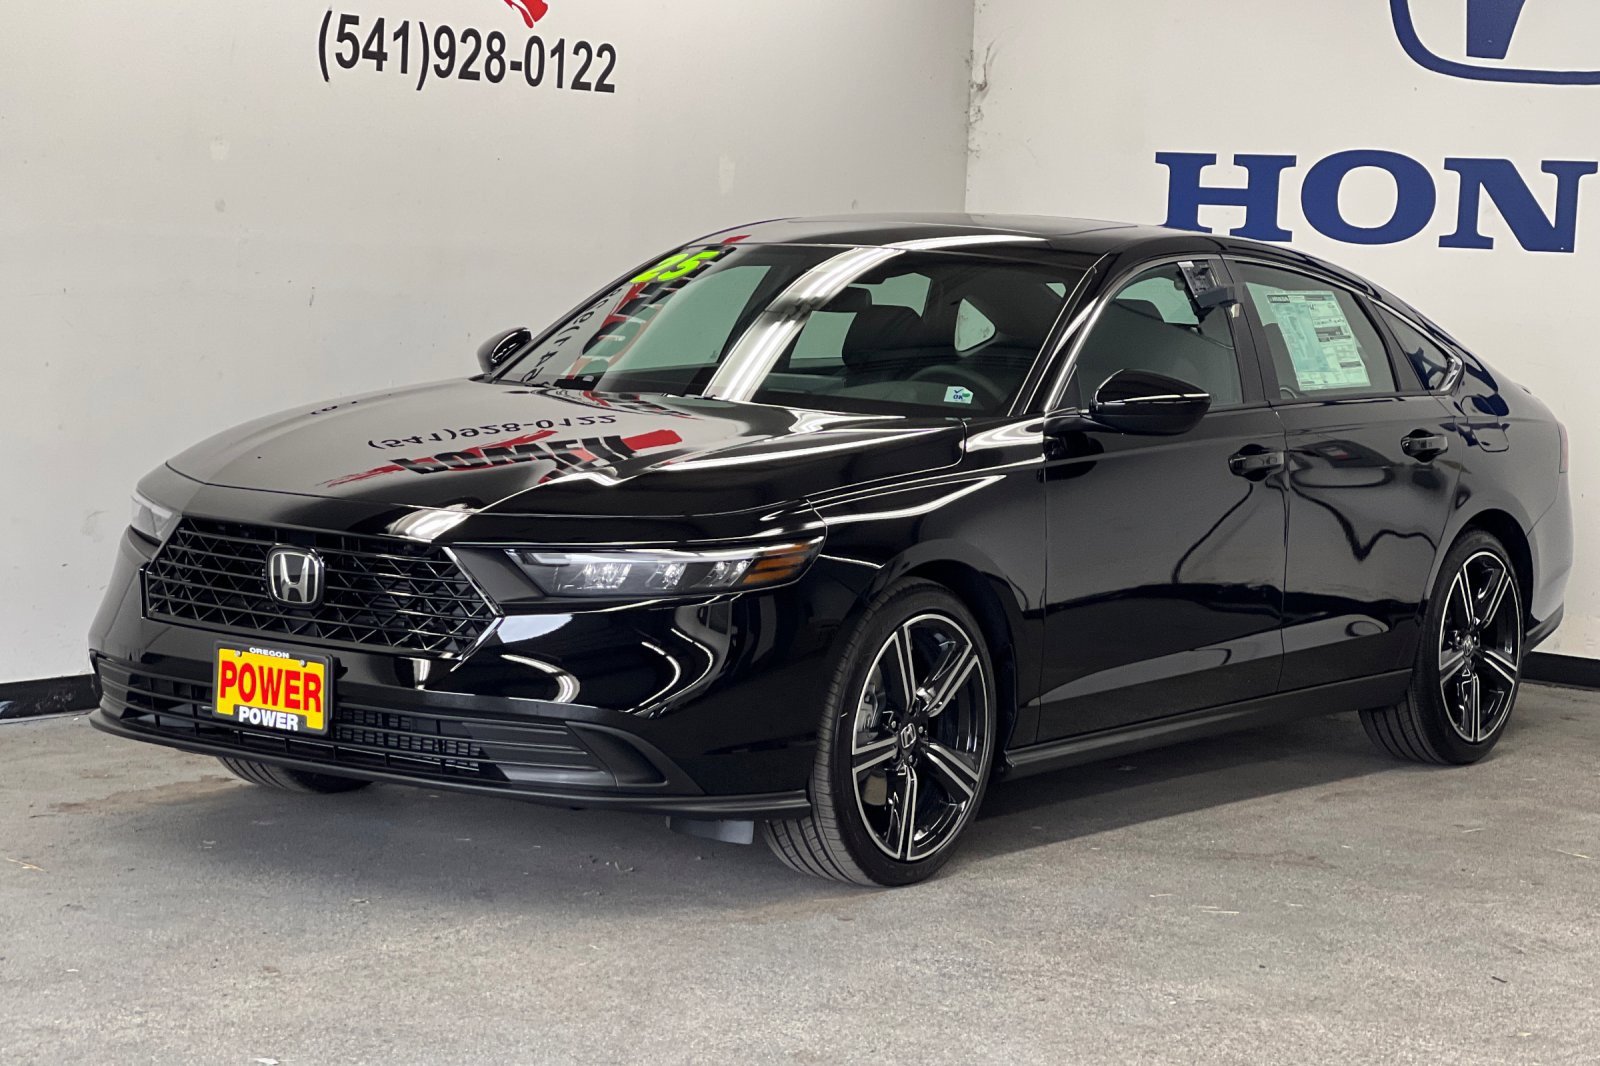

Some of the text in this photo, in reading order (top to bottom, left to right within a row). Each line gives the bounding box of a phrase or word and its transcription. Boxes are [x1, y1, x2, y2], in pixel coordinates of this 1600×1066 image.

[318, 9, 617, 94] (541)928-0122
[249, 647, 290, 659] OREGON
[220, 660, 322, 713] POWER
[238, 705, 299, 731] POWER
